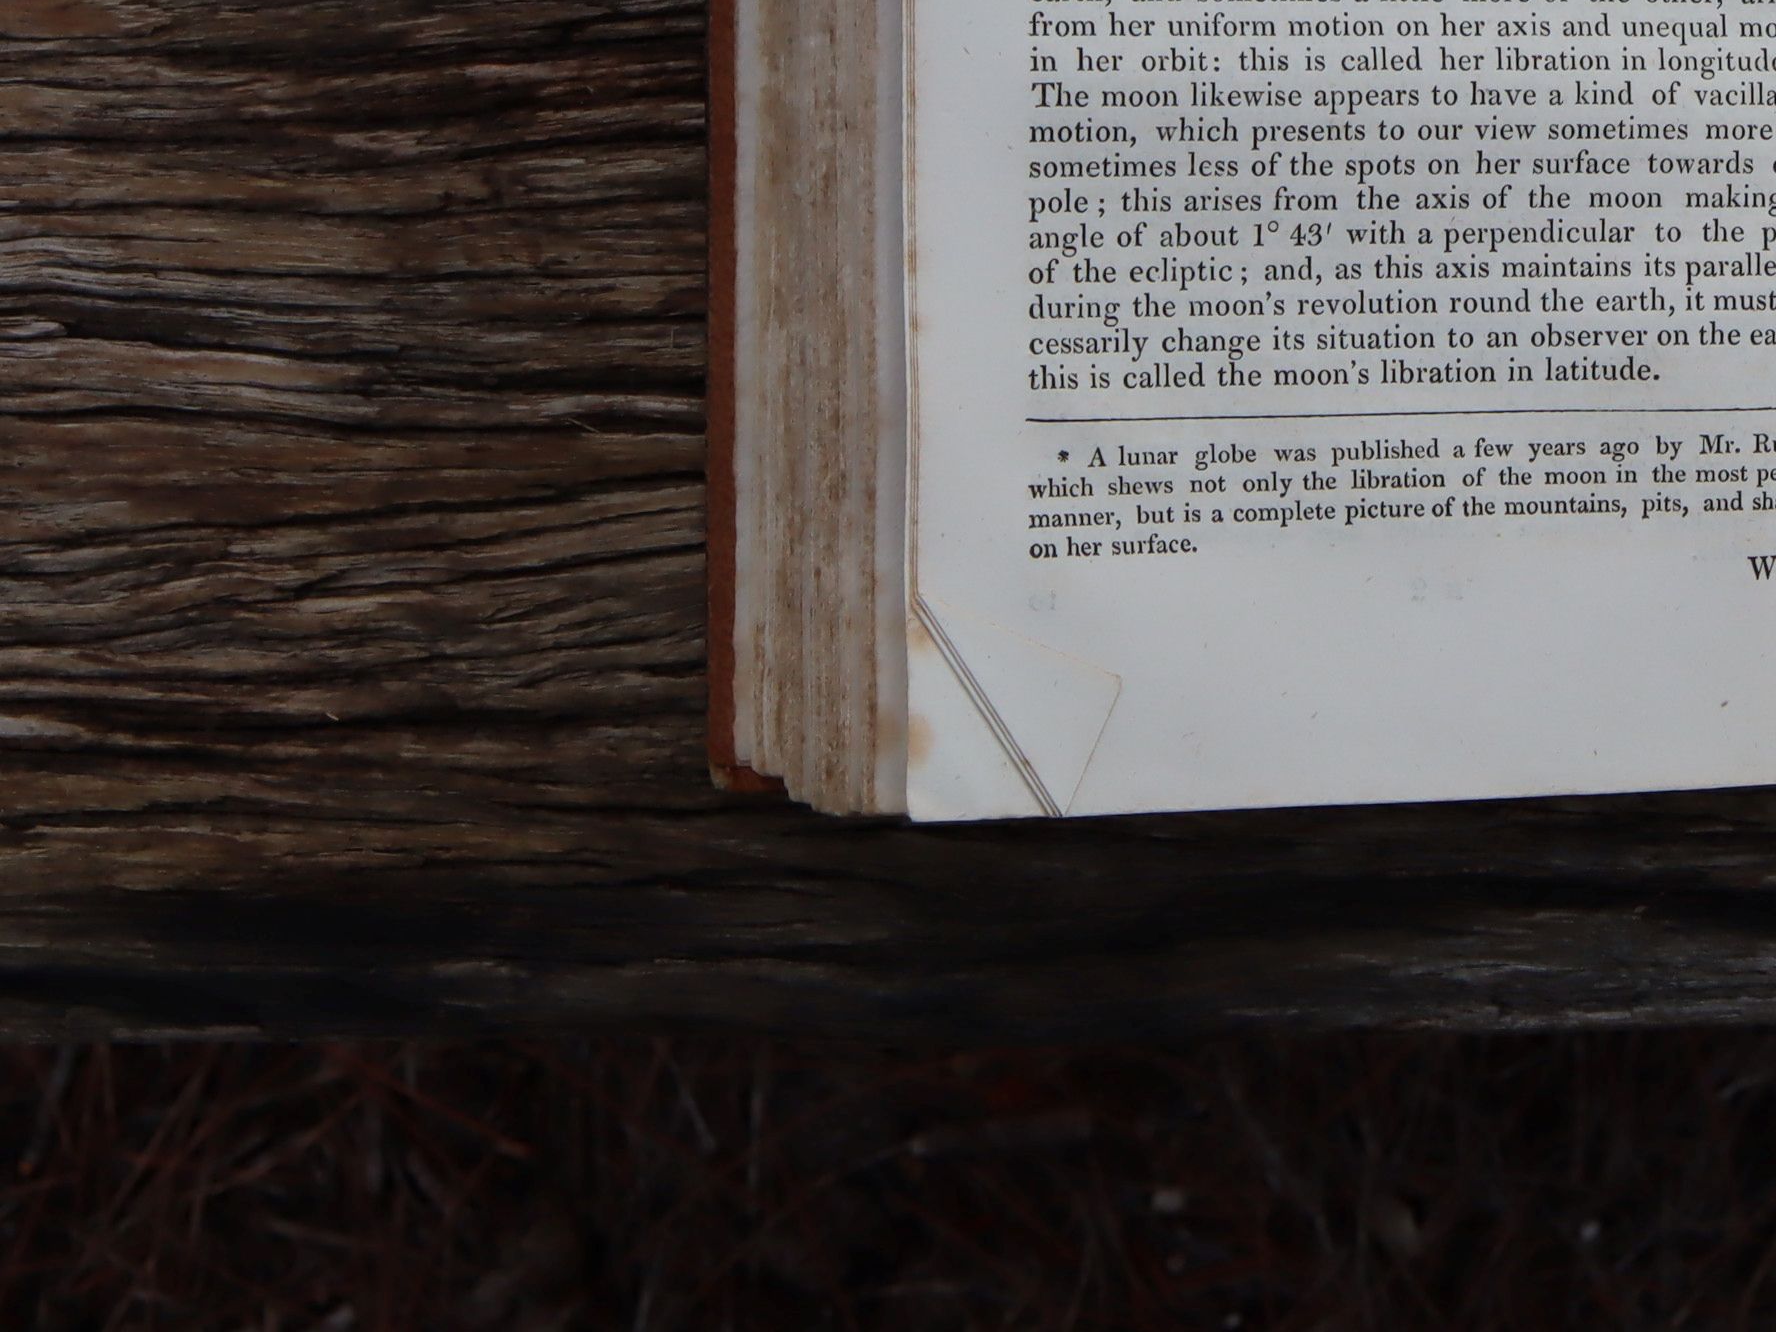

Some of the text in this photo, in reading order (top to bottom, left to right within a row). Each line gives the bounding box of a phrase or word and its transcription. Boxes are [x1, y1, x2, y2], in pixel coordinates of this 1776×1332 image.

[1028, 327, 1150, 363] cessarily
[1161, 326, 1261, 361] change
[1272, 324, 1306, 352] its
[1316, 322, 1436, 351] situation
[1447, 327, 1475, 349] to
[1486, 331, 1519, 349] an
[1530, 322, 1649, 349] observer
[1656, 329, 1690, 347] on
[1698, 320, 1741, 347] the
[1027, 475, 1095, 500] which
[1107, 474, 1174, 496] shews
[1188, 475, 1227, 494] not
[1241, 470, 1294, 499] only
[1301, 470, 1338, 492] the
[1350, 466, 1447, 490] libration
[1461, 466, 1487, 488] of
[1497, 465, 1533, 486] the
[1543, 470, 1608, 486] moon
[1615, 469, 1638, 484] in
[1651, 463, 1687, 484] the
[1694, 465, 1749, 484] most
[1028, 532, 1198, 560] on her surface.
